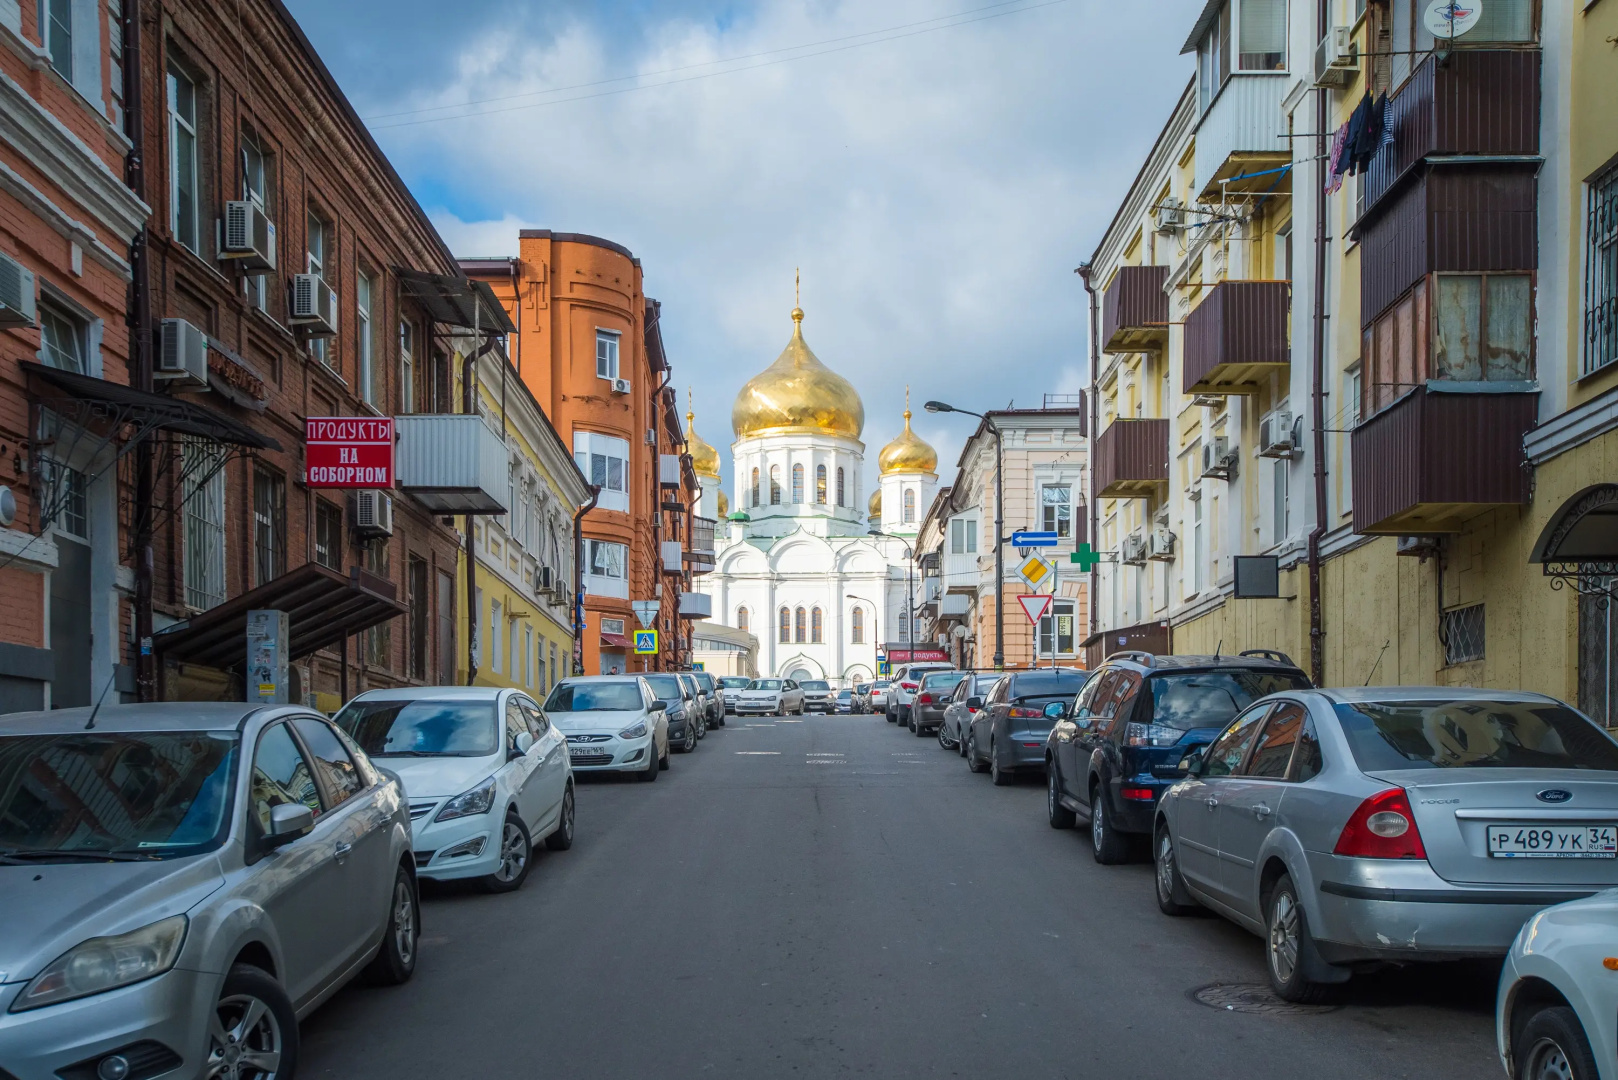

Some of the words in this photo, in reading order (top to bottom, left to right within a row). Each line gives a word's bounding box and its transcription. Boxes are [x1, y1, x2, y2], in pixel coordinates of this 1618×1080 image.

[307, 422, 391, 439] ПРОДУКТЫ
[339, 447, 359, 464] НА
[310, 466, 387, 483] СОБОРНОМ
[1545, 791, 1566, 800] Ford
[1589, 828, 1610, 844] 34
